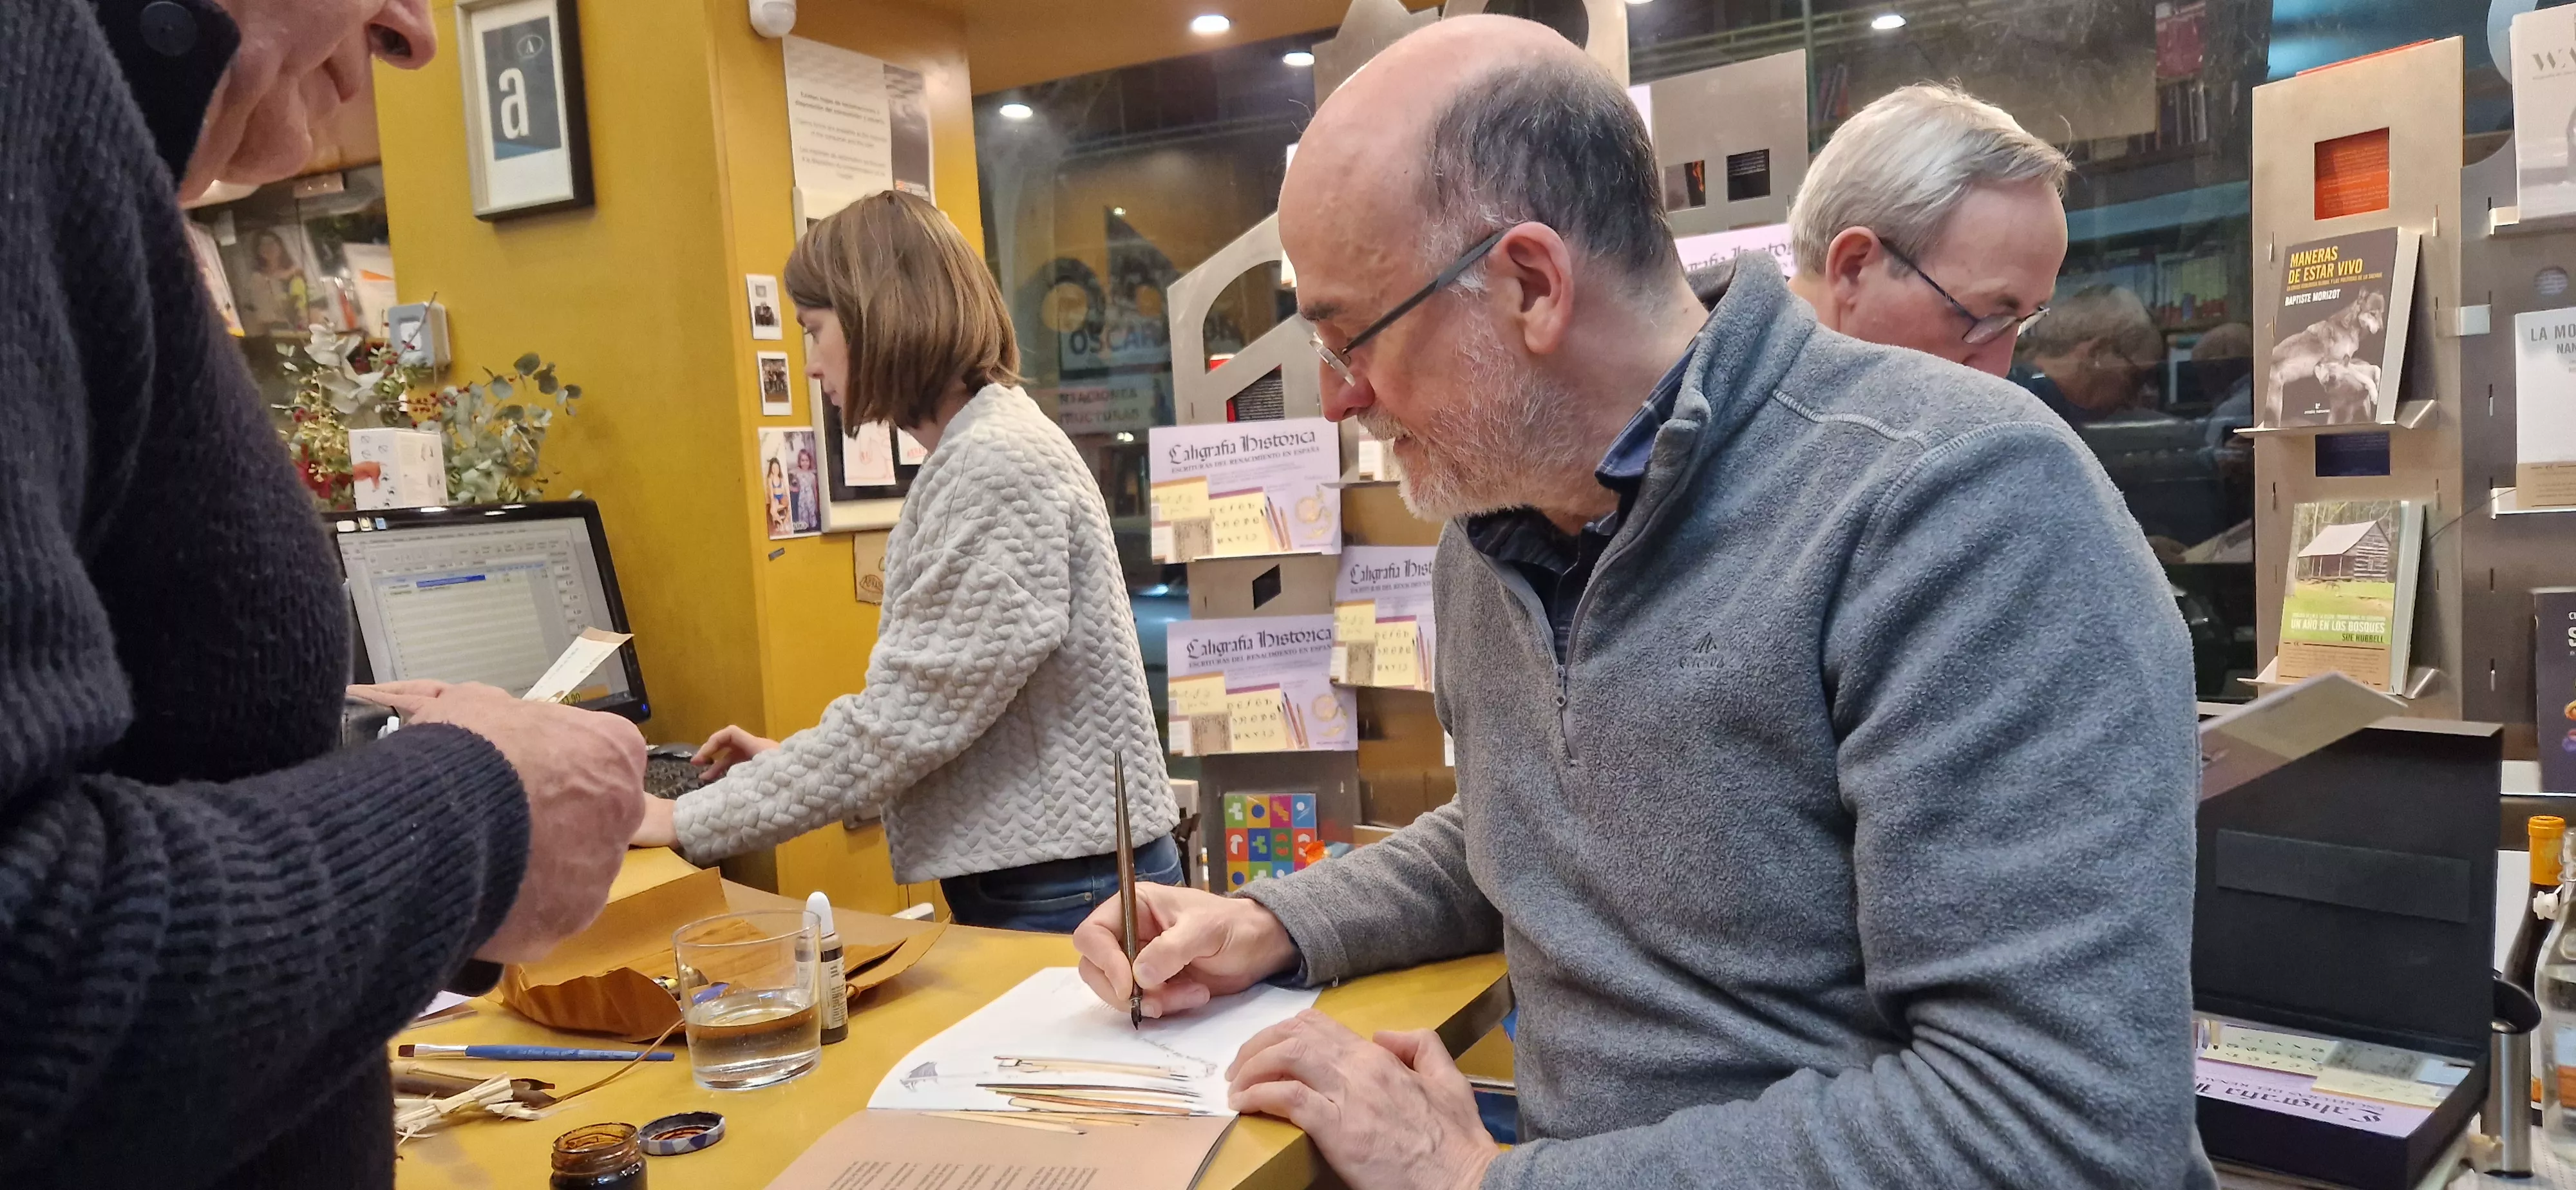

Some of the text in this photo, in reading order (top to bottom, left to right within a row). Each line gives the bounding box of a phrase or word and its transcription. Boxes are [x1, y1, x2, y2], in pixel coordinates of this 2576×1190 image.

[498, 68, 529, 139] a
[2290, 245, 2338, 268] MANERAS
[2287, 258, 2363, 284] DE ESTAR VIVO
[2284, 288, 2341, 307] BAPTISTE MORIZOT
[2531, 326, 2548, 341] LA
[1240, 430, 1316, 453] Histórica
[1171, 462, 1213, 474] ESCRITURAS
[1229, 452, 1281, 465] RENACIMIENTO
[2291, 618, 2300, 629] UN
[2320, 620, 2330, 630] EN
[2331, 621, 2346, 632] LOS
[2348, 621, 2385, 634] BOSQUES
[1257, 628, 1332, 648] Histórica
[2342, 633, 2384, 643] SUE HUBBELL
[1189, 657, 1230, 668] ESCRITURAS
[1246, 648, 1297, 661] RENACIMIENTO
